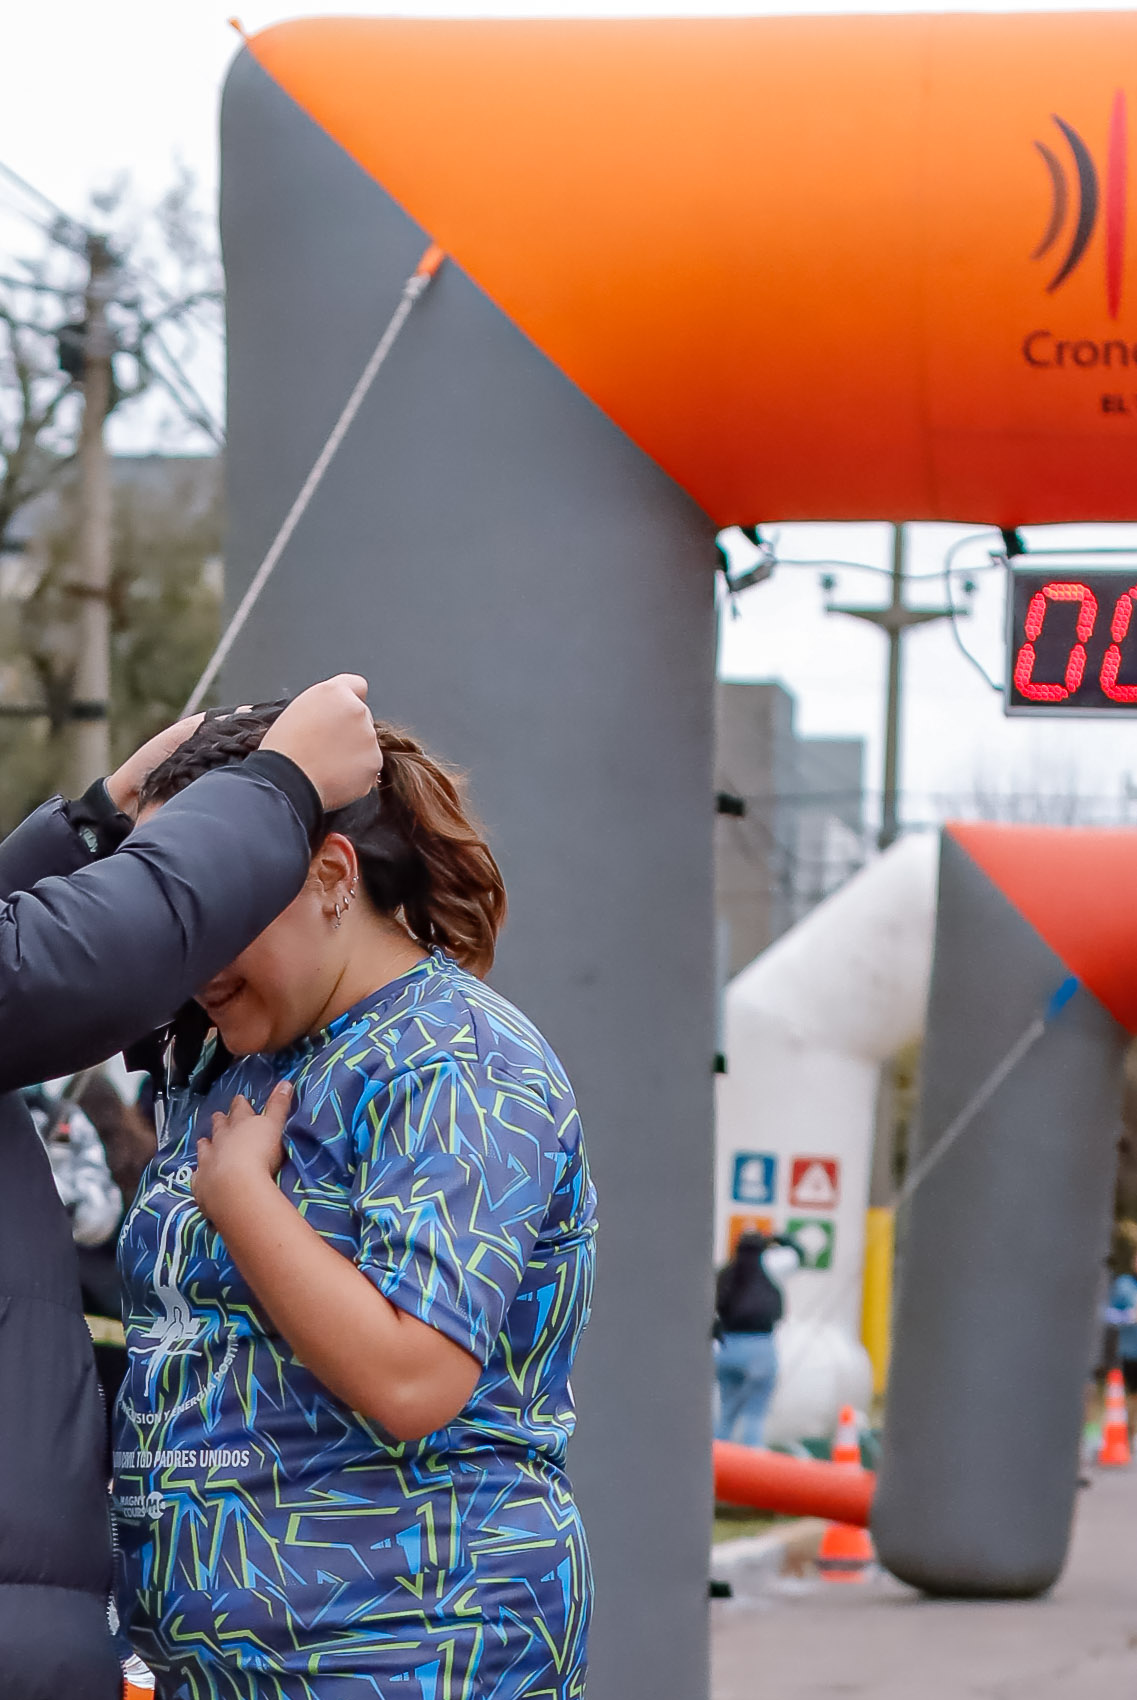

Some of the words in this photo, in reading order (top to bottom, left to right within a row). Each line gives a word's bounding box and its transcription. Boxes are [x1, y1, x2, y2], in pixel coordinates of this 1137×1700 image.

[1022, 329, 1137, 368] Cron
[154, 1450, 197, 1468] PADRES
[199, 1449, 250, 1468] UNIDOS
